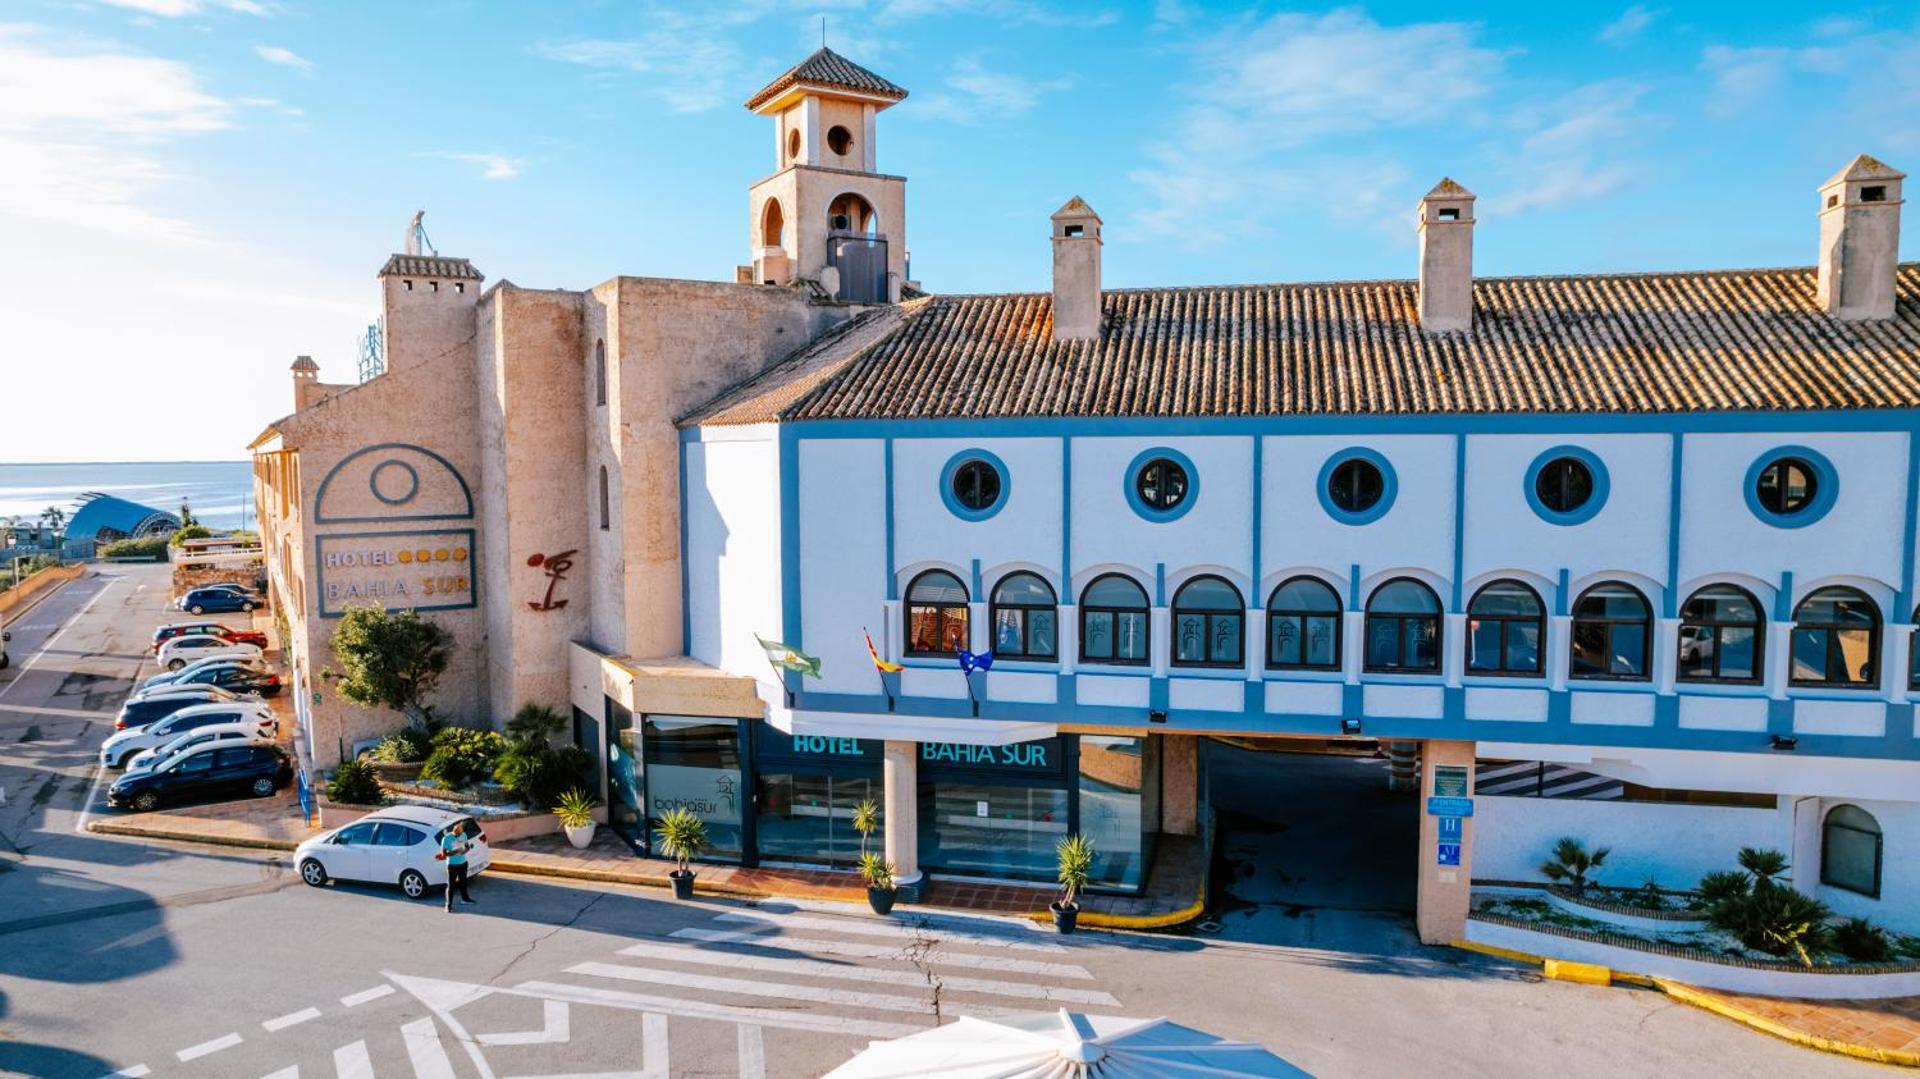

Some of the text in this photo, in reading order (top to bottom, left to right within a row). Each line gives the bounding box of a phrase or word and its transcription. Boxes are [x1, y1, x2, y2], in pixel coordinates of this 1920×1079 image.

[326, 551, 395, 569] HOTEL
[327, 575, 470, 600] BAHIA SUR
[793, 735, 1047, 767] HOTEL BAHIA SUR
